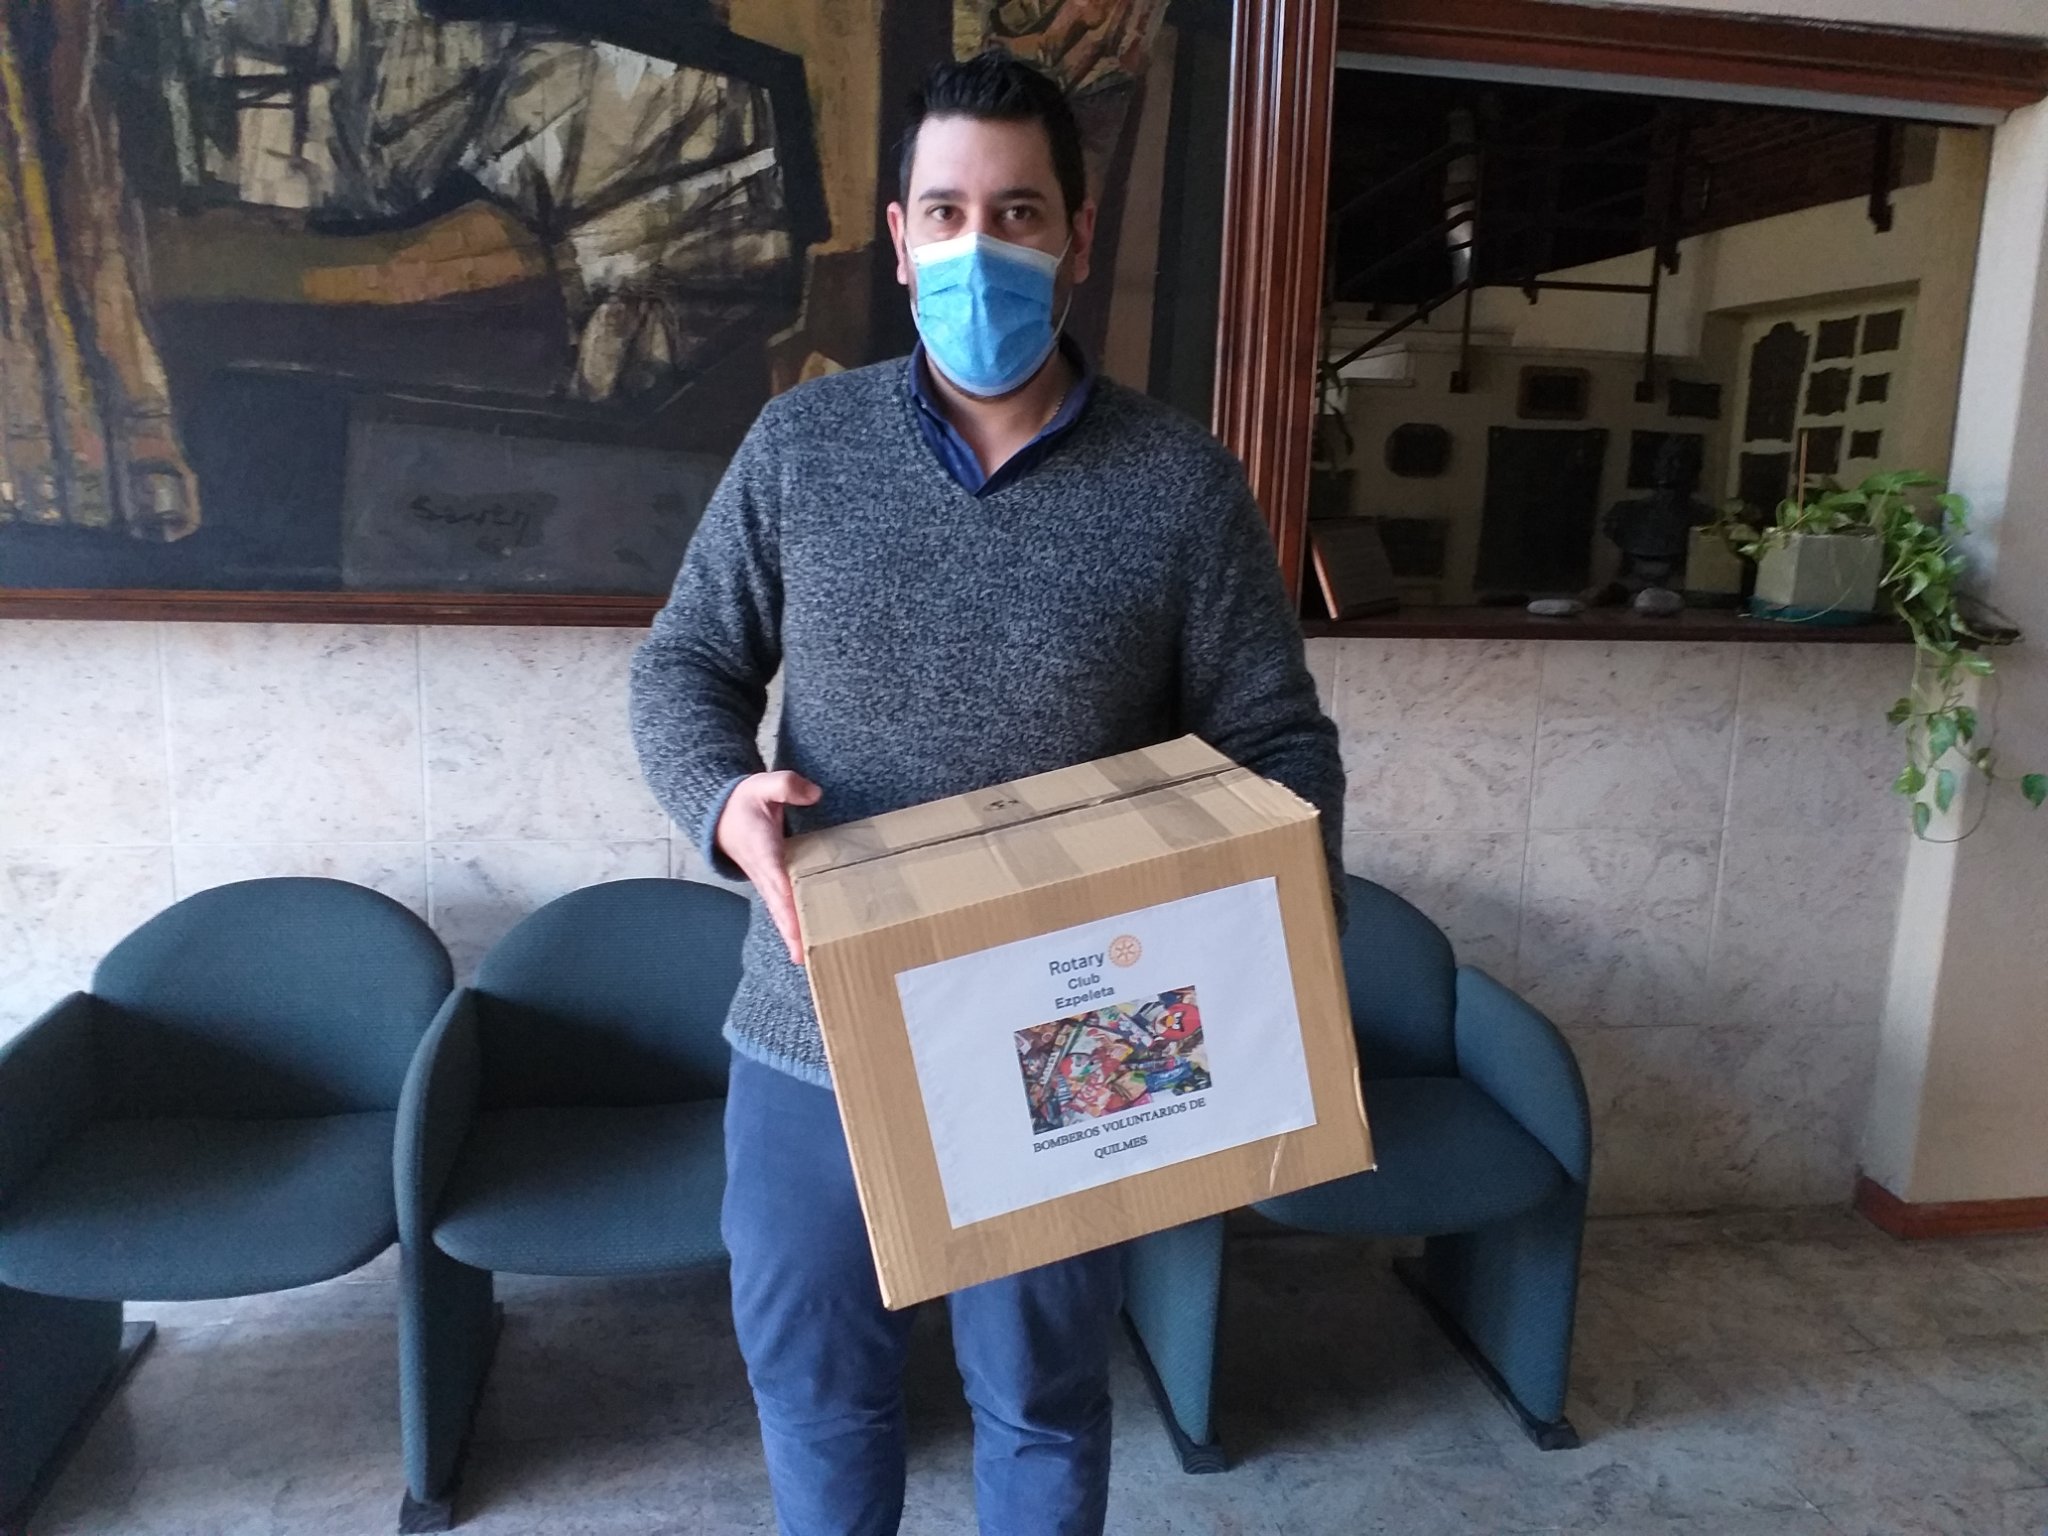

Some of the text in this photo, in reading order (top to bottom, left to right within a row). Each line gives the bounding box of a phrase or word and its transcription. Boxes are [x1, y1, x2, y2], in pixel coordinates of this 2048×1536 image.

[1049, 952, 1104, 976] Rotary
[1068, 973, 1101, 990] Club
[1055, 986, 1115, 1010] Ezpeleta
[1032, 1097, 1206, 1153] BOMBEROS VOLUNTARIOS DE
[1094, 1135, 1148, 1158] QUILMES
